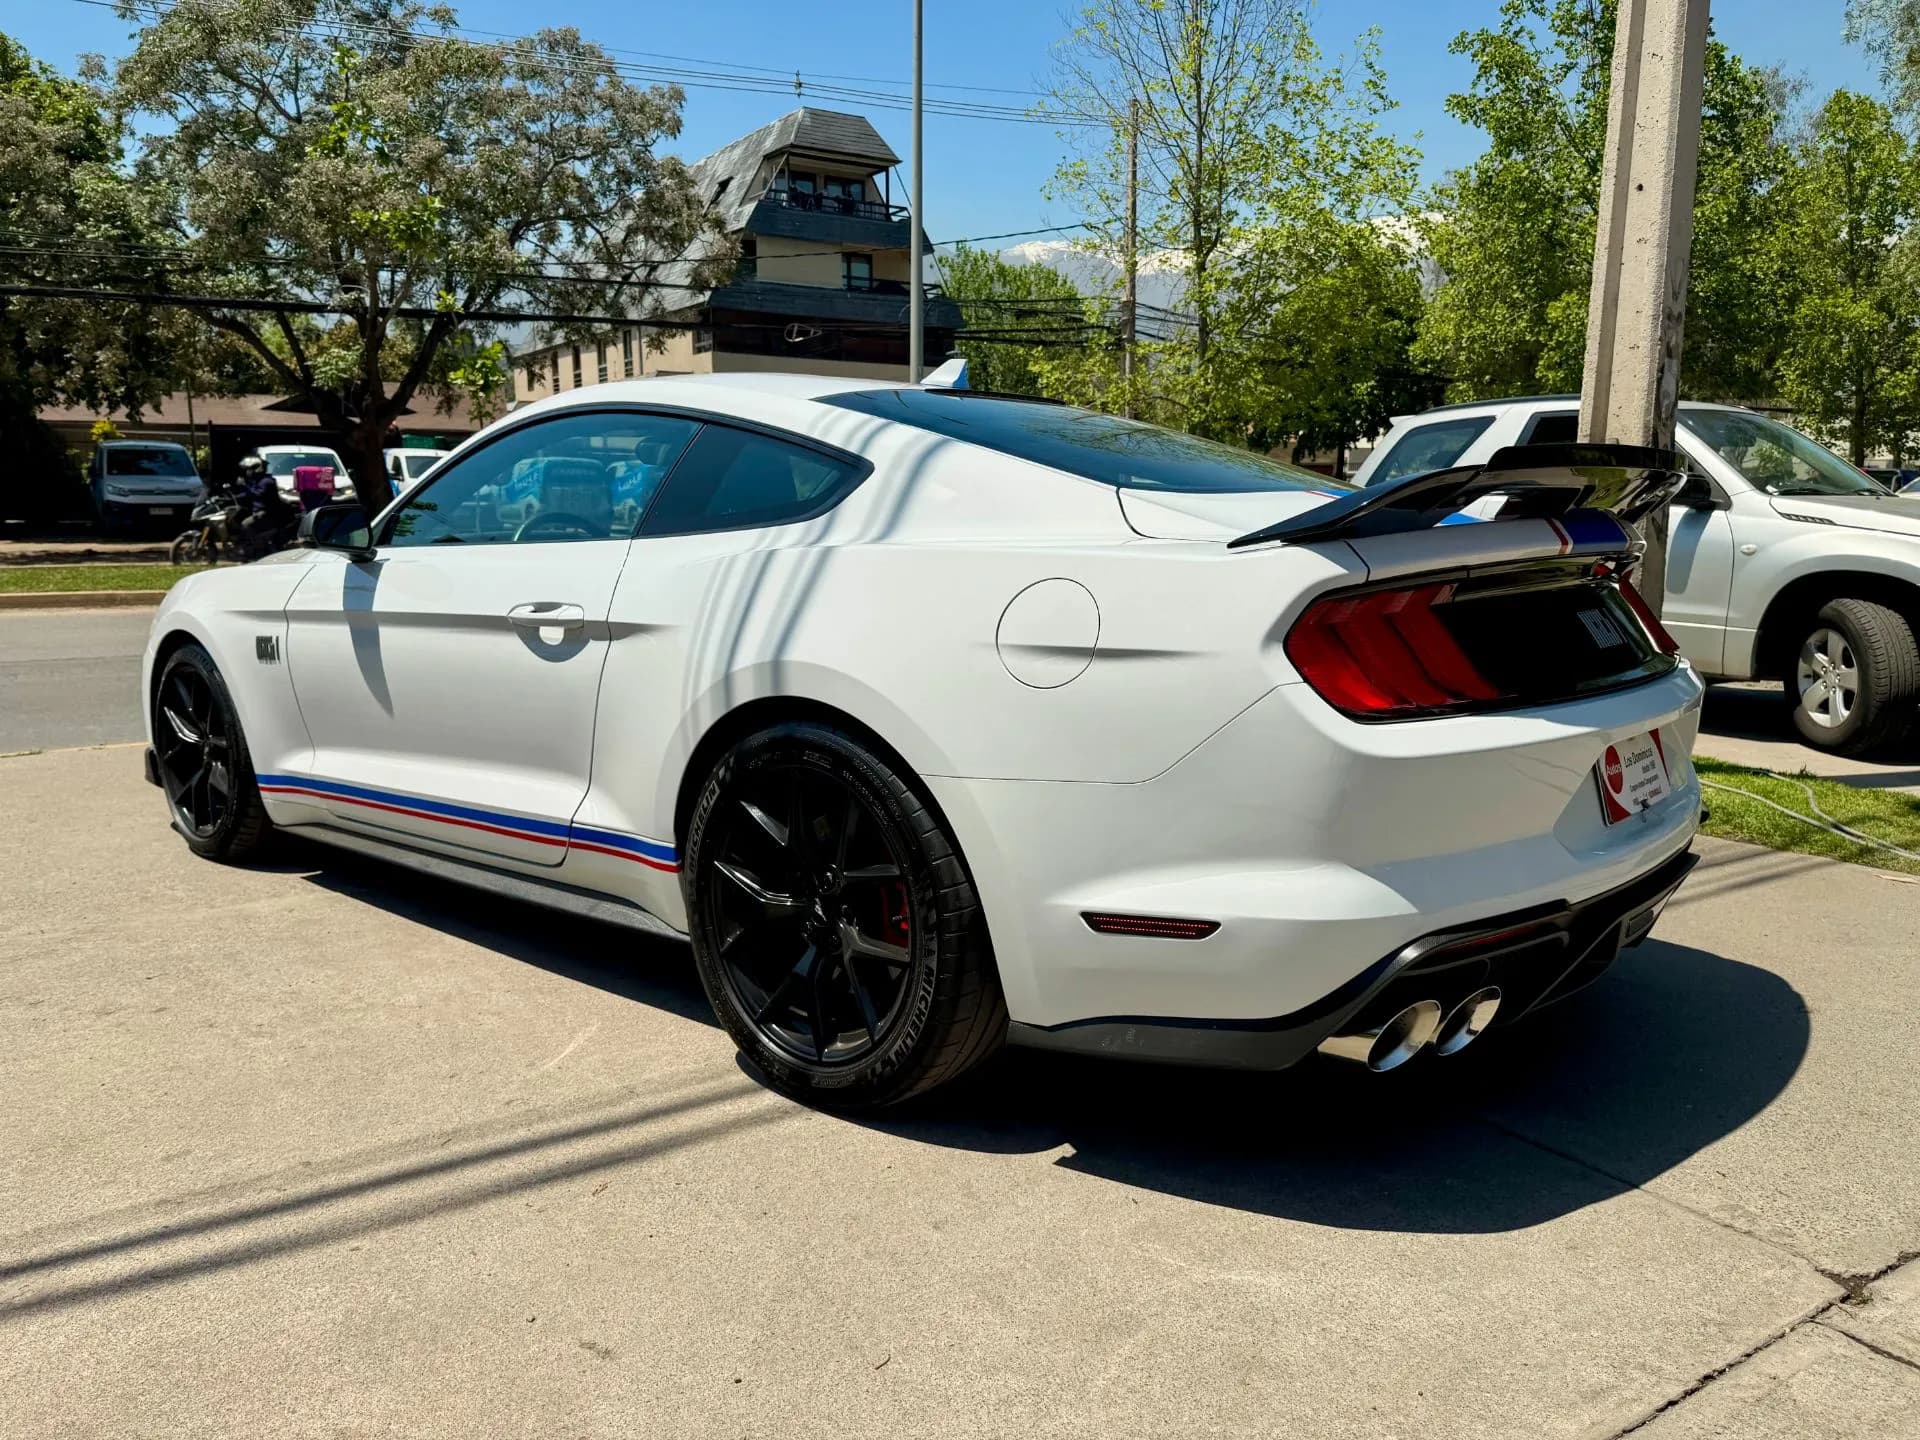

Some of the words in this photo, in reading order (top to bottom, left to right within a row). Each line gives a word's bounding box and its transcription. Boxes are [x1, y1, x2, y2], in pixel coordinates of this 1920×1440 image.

[1606, 763, 1622, 776] Autos
[1623, 753, 1633, 768] Los
[688, 781, 720, 873] MICHELIN
[894, 965, 935, 1063] MICHELIN
